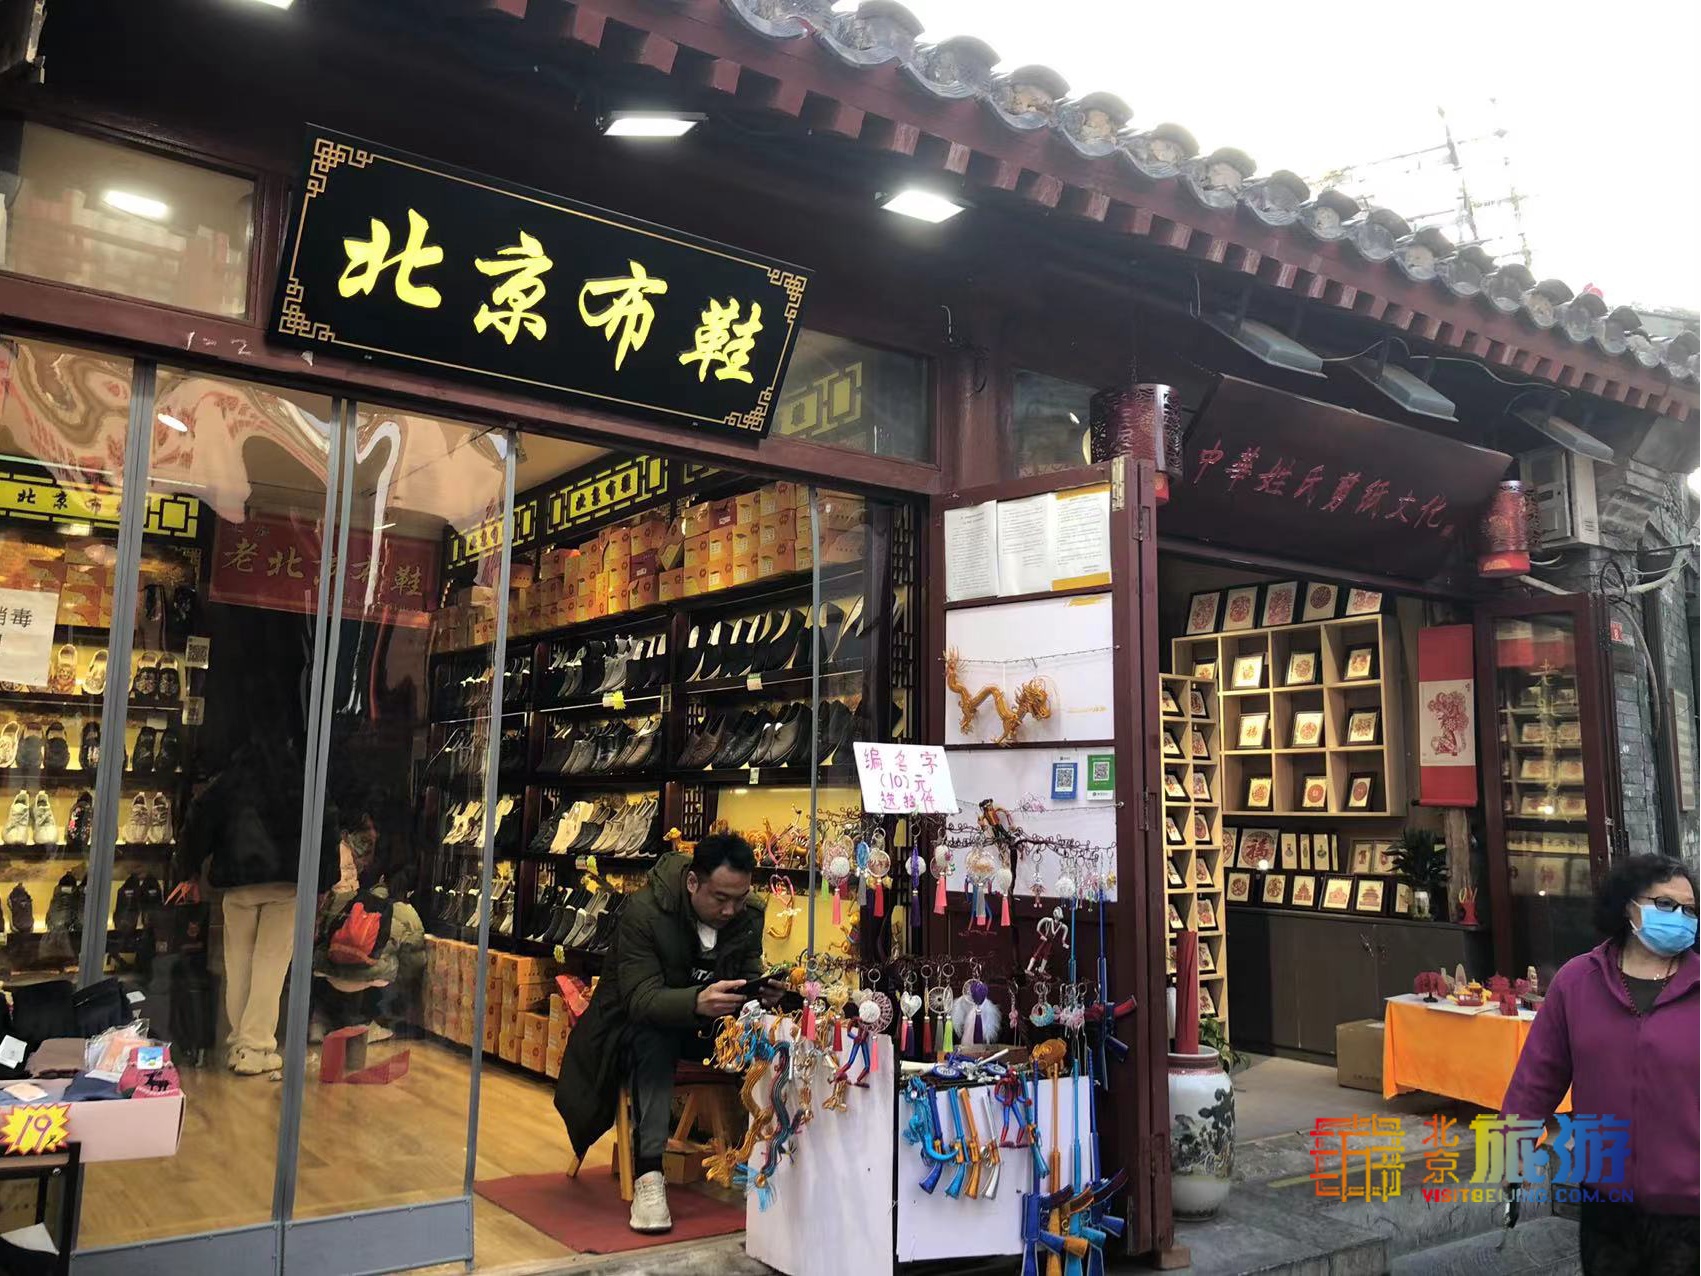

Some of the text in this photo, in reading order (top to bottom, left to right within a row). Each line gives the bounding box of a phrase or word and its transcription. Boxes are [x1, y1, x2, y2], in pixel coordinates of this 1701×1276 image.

[338, 207, 764, 384] 北京布鞋
[17, 487, 122, 516] 北京布
